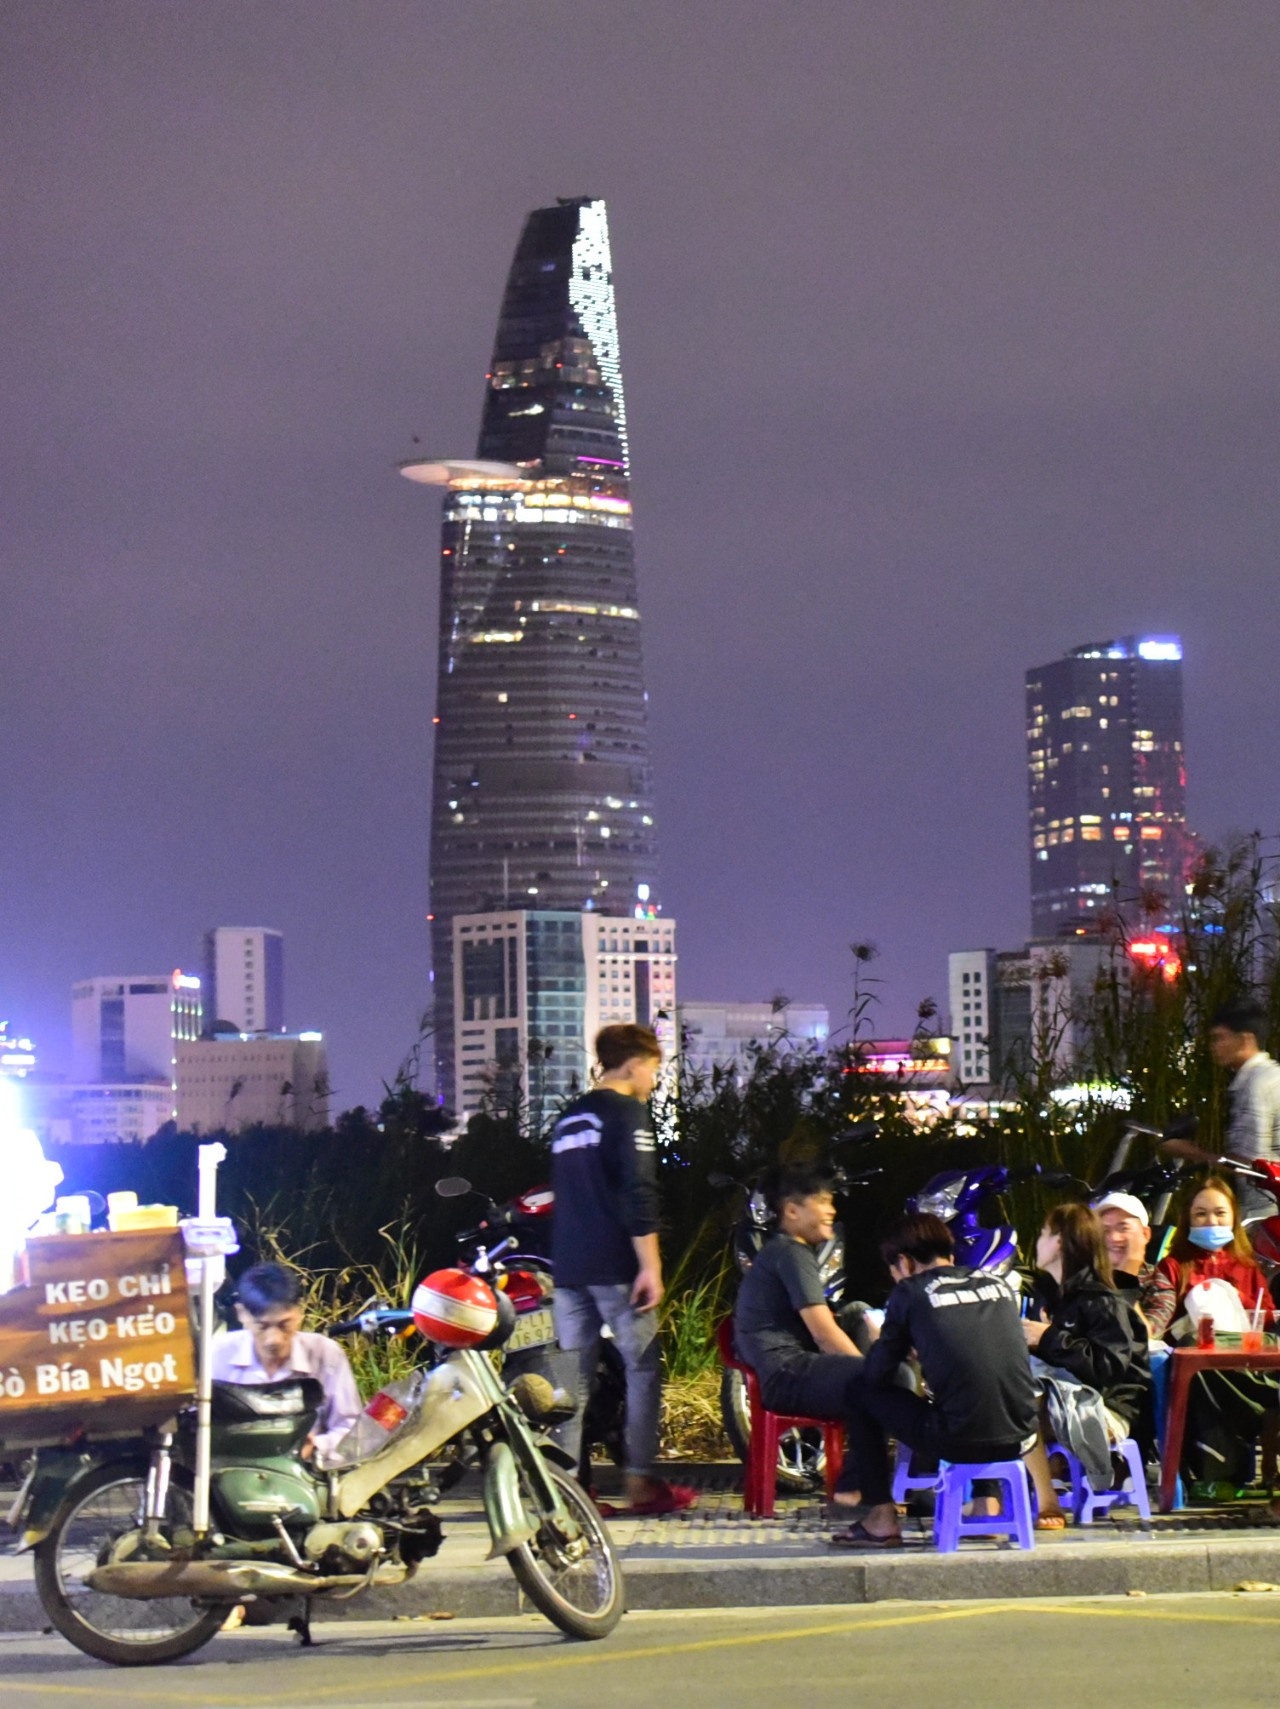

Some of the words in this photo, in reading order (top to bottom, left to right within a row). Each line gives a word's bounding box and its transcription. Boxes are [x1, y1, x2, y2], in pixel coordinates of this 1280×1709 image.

[50, 1318, 109, 1348] KẸO
[36, 1362, 91, 1395] Bía
[100, 1353, 178, 1392] Ngọt
